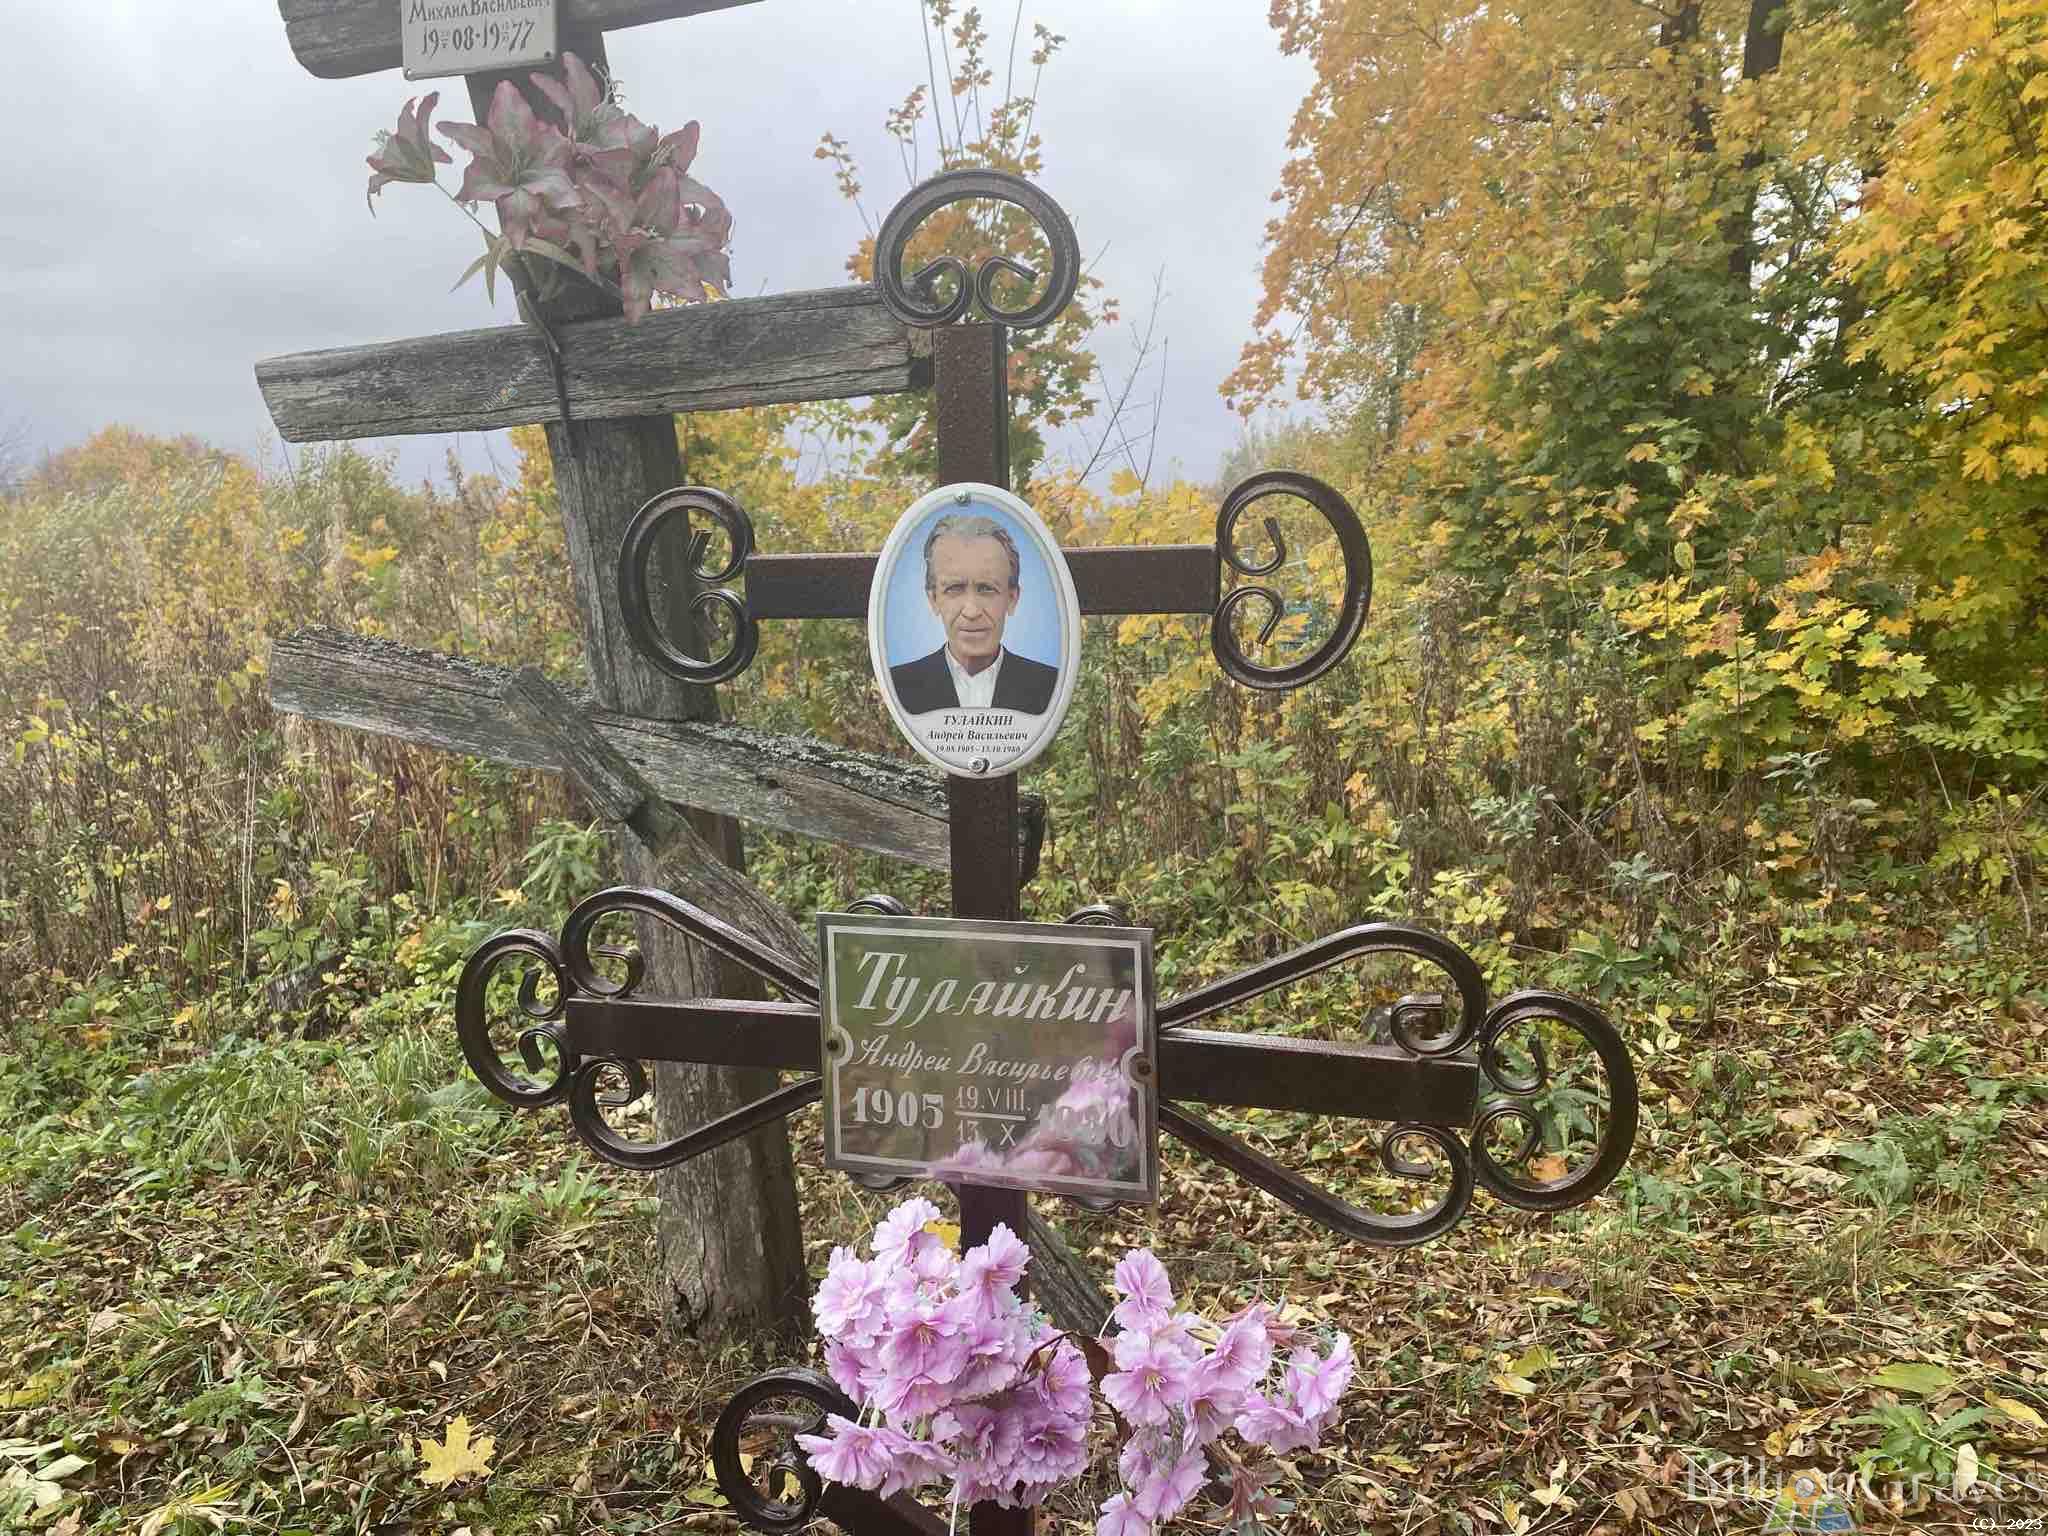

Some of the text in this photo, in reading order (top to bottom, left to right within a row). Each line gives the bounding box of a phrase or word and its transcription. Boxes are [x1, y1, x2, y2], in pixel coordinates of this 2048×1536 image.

[943, 713, 1014, 726] ТУЛАЙКИН
[928, 730, 1029, 742] Андрей Васильевич
[852, 951, 1133, 1028] Тулайкин
[850, 1087, 944, 1129] 1905
